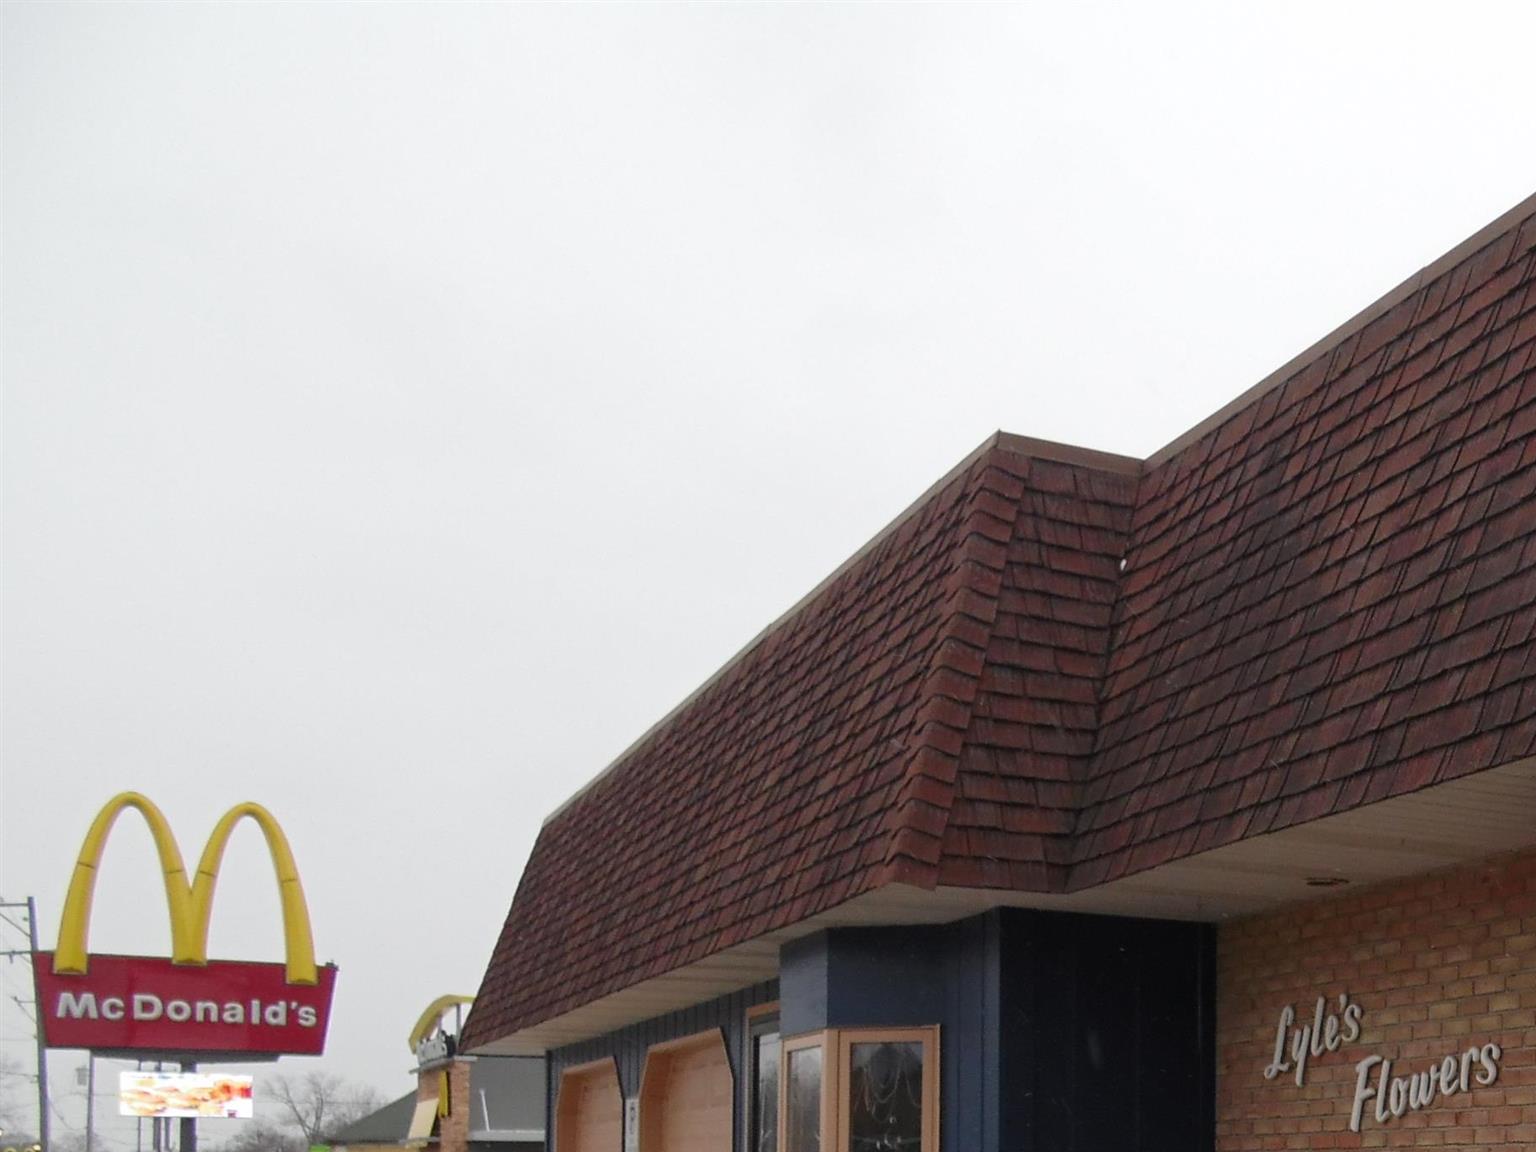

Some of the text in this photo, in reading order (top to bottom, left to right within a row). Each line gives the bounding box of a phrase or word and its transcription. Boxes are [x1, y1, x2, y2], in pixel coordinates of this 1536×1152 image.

[57, 992, 317, 1027] McDonald's
[1264, 994, 1363, 1086] Lyle's
[1350, 1043, 1502, 1132] Flowers
